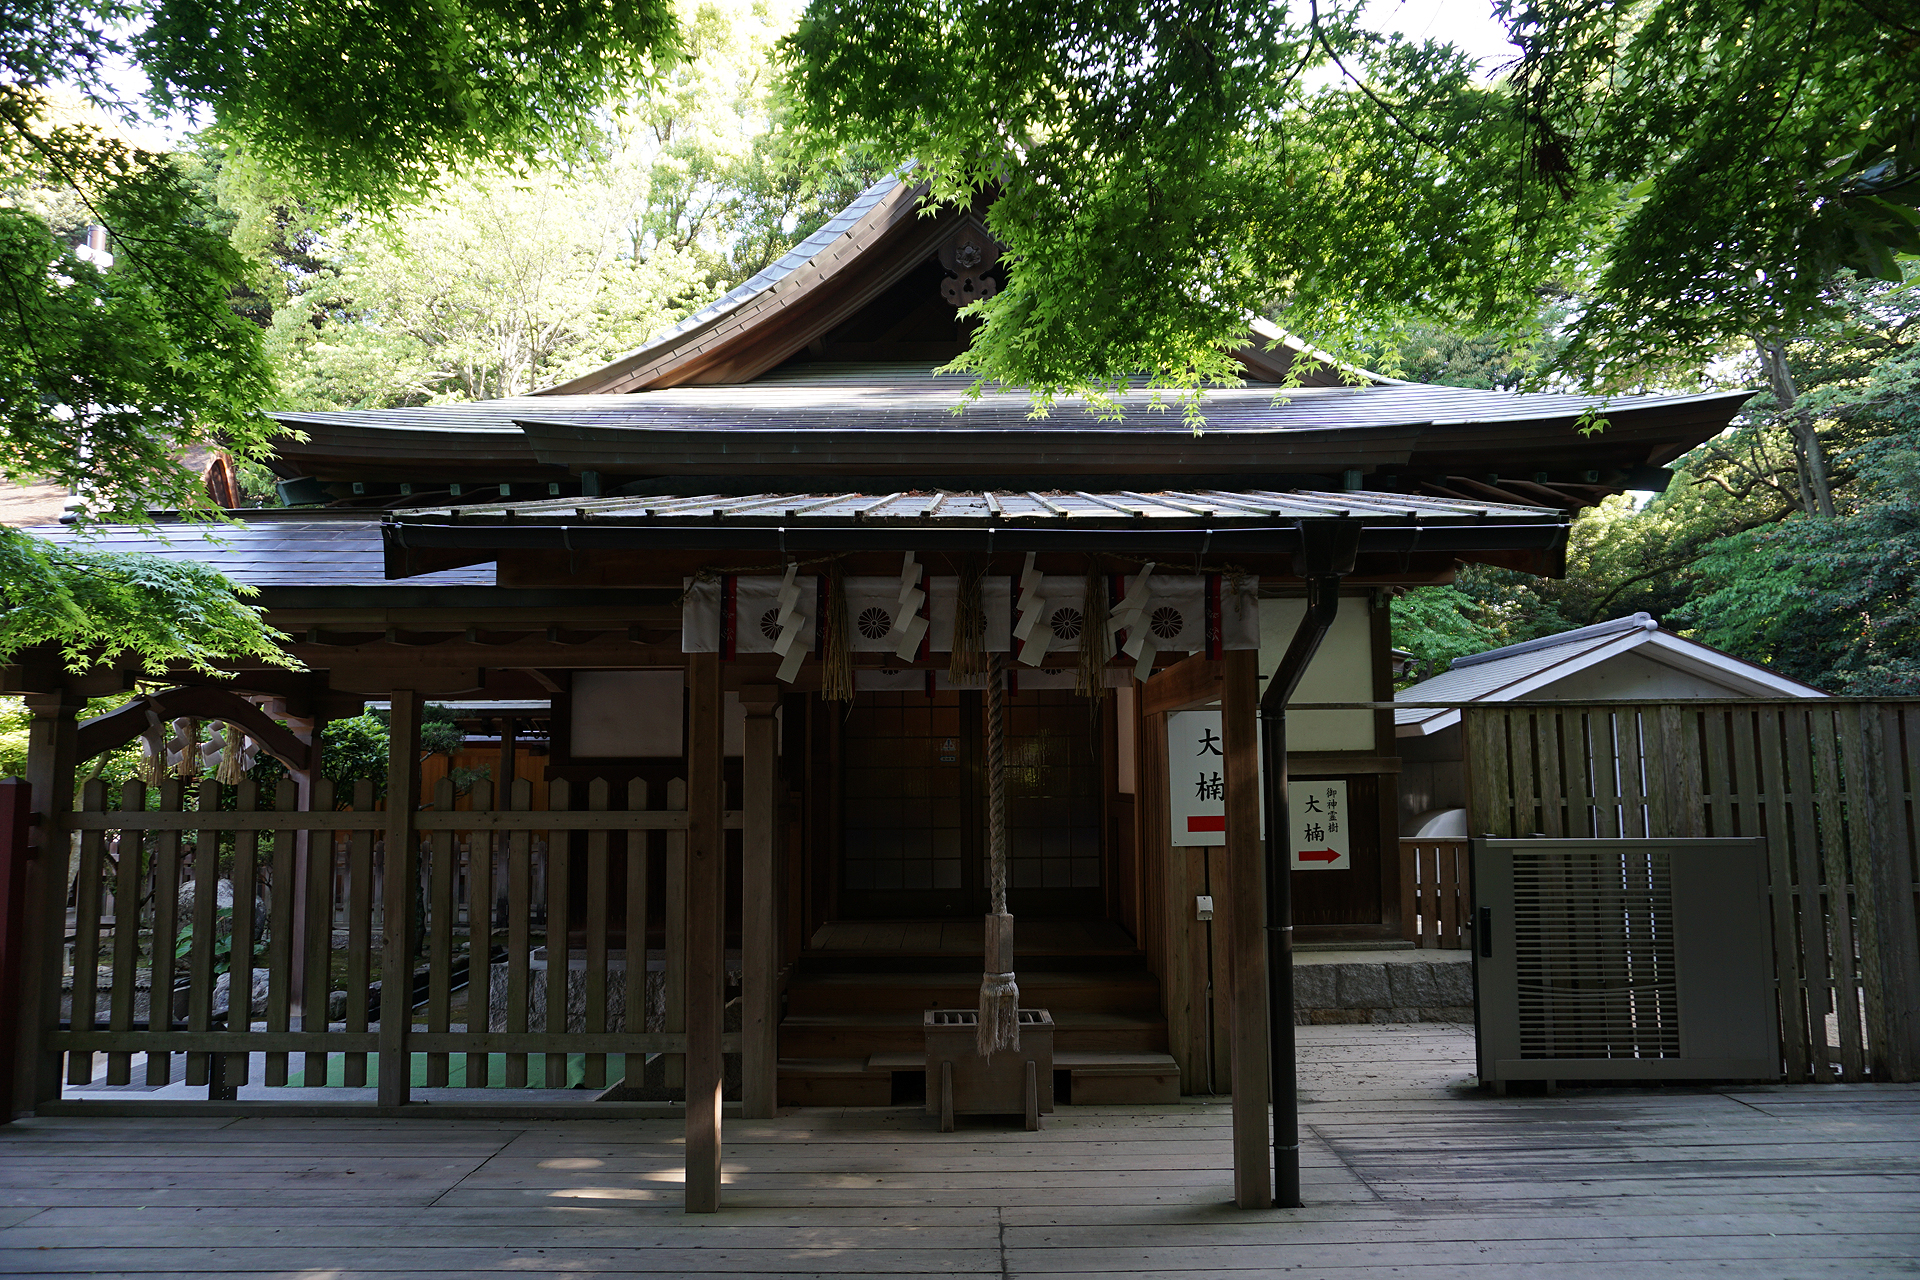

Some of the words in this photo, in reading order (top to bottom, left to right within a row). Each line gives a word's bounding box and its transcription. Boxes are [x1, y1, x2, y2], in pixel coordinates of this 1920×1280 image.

[1195, 728, 1225, 802] 大楠
[1304, 795, 1325, 842] 大楠
[1326, 787, 1339, 833] 御神霊樹
